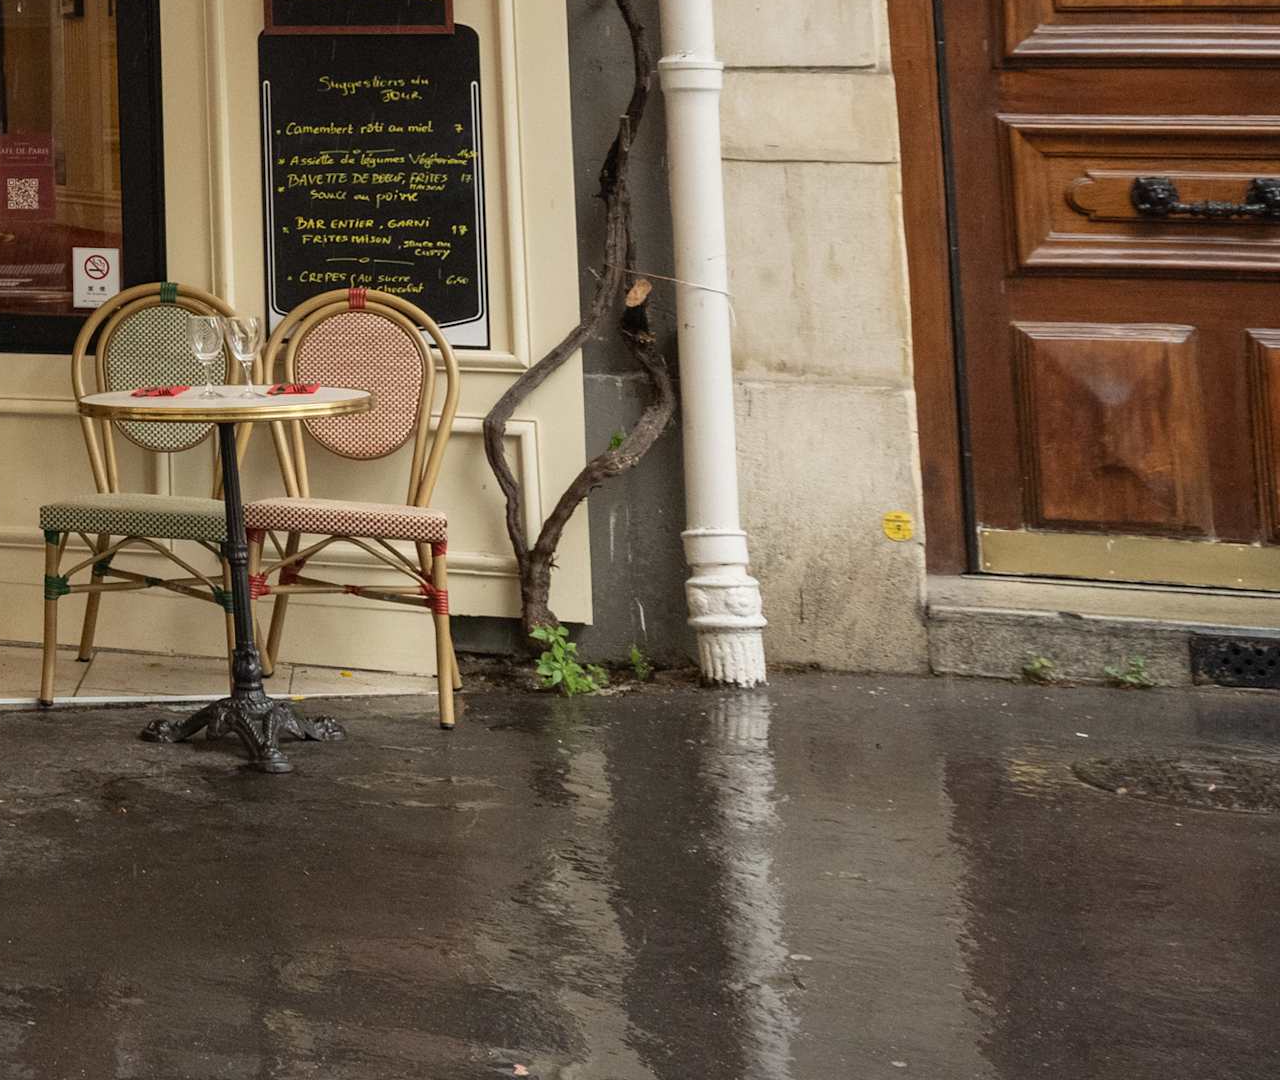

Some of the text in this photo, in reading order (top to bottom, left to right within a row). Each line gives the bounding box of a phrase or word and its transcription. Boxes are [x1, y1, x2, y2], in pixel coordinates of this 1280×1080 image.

[285, 122, 353, 135] Camembert
[388, 124, 404, 133] au
[408, 120, 433, 133] miel
[290, 155, 334, 166] Assiette
[340, 152, 355, 164] de
[352, 173, 369, 184] DE
[295, 216, 327, 229] BAR
